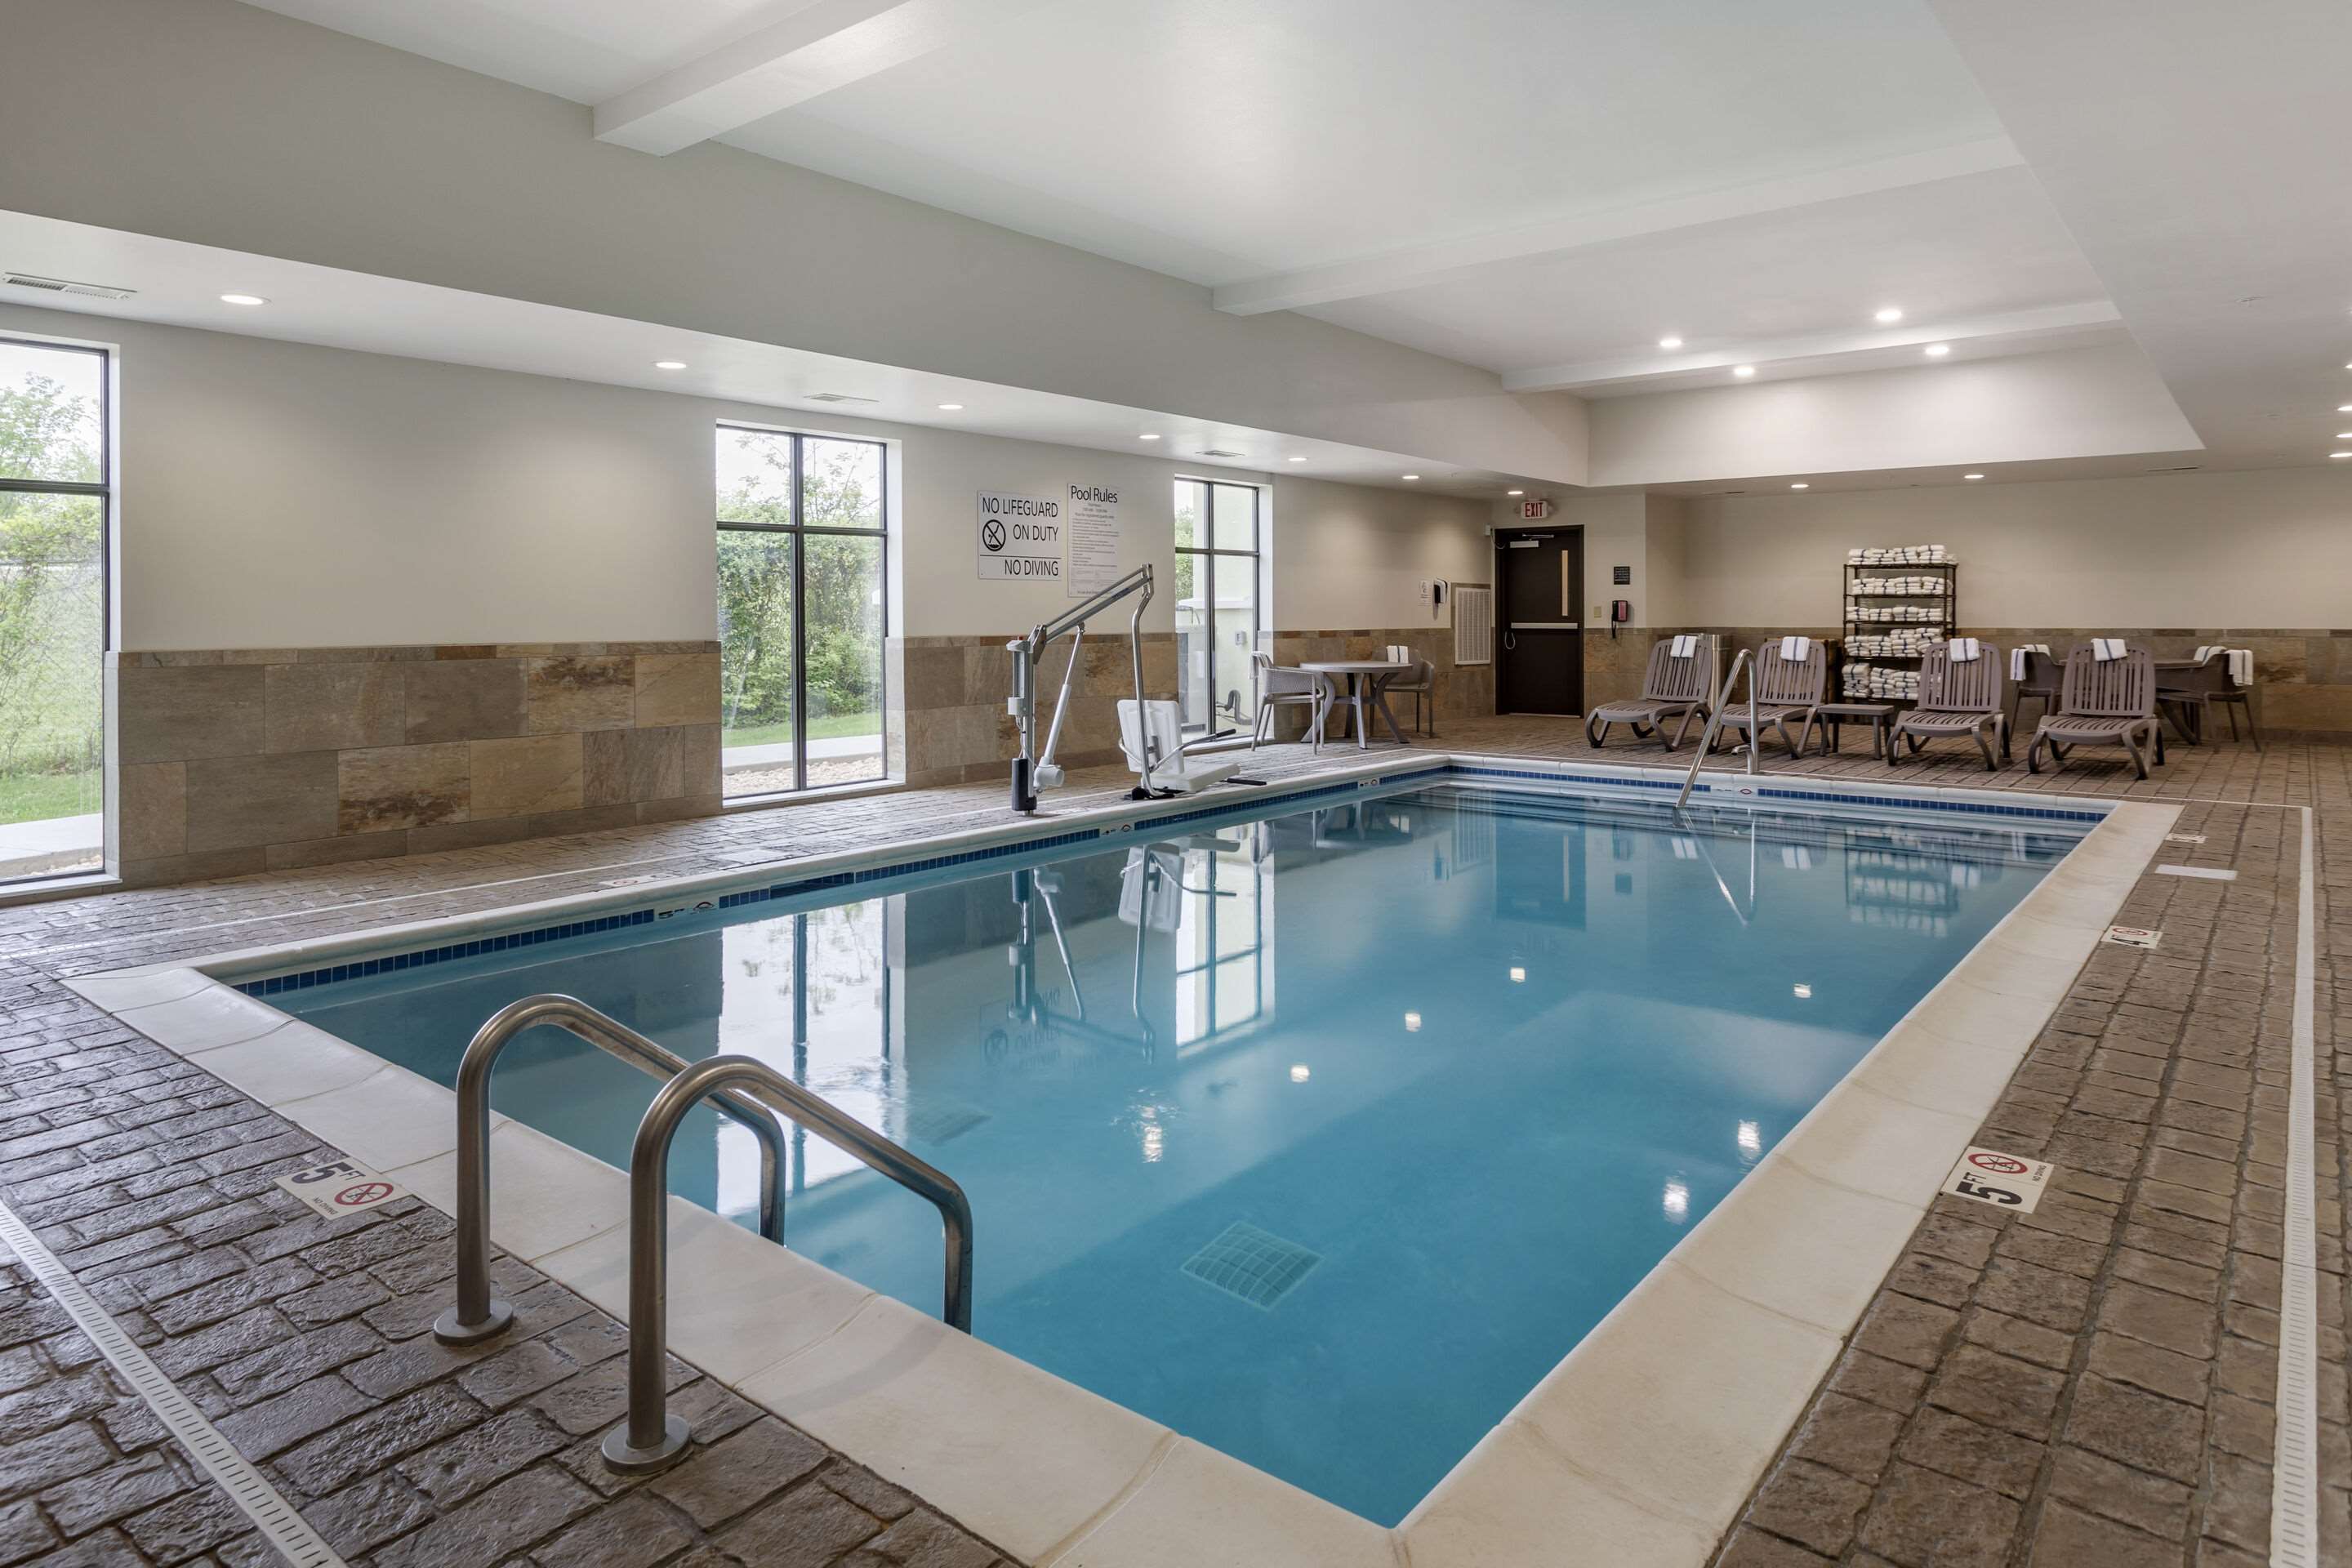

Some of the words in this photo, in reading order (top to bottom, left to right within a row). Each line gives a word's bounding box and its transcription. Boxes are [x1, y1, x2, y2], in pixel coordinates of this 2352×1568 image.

[1071, 485, 1091, 501] Pool
[1094, 488, 1118, 503] Rules
[982, 497, 1000, 514] NO
[1003, 499, 1058, 517] LIFEGUARD
[1525, 502, 1544, 517] EXIT
[1013, 524, 1030, 540] ON
[1032, 526, 1058, 541] DUTY
[1004, 559, 1022, 575] NO
[1024, 560, 1058, 576] DIVING
[291, 1161, 354, 1184] 5
[339, 1170, 366, 1181] FT
[1962, 1171, 1987, 1184] FT
[1955, 1181, 2023, 1205] 5
